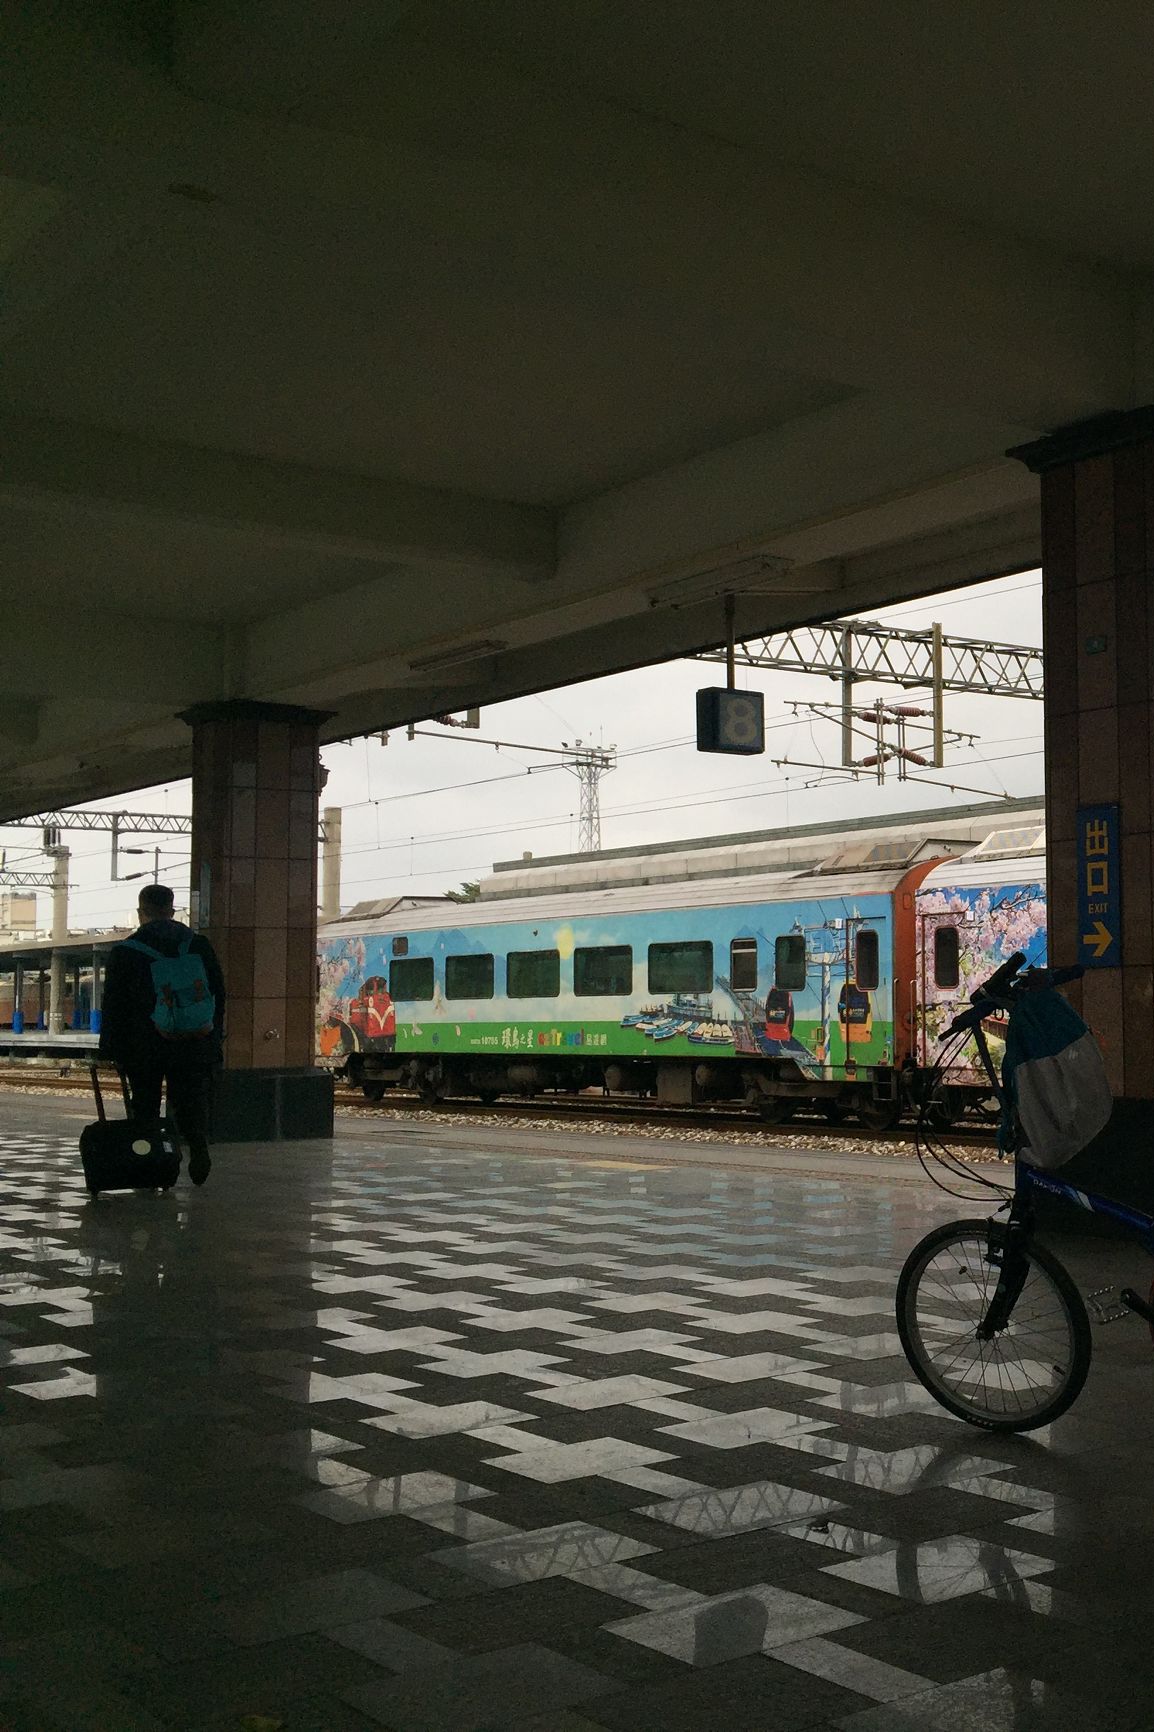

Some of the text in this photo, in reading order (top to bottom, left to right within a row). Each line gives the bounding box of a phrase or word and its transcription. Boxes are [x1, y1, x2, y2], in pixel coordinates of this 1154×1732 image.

[724, 698, 756, 744] 8
[1086, 819, 1109, 897] 出口
[1088, 903, 1108, 915] EXIT
